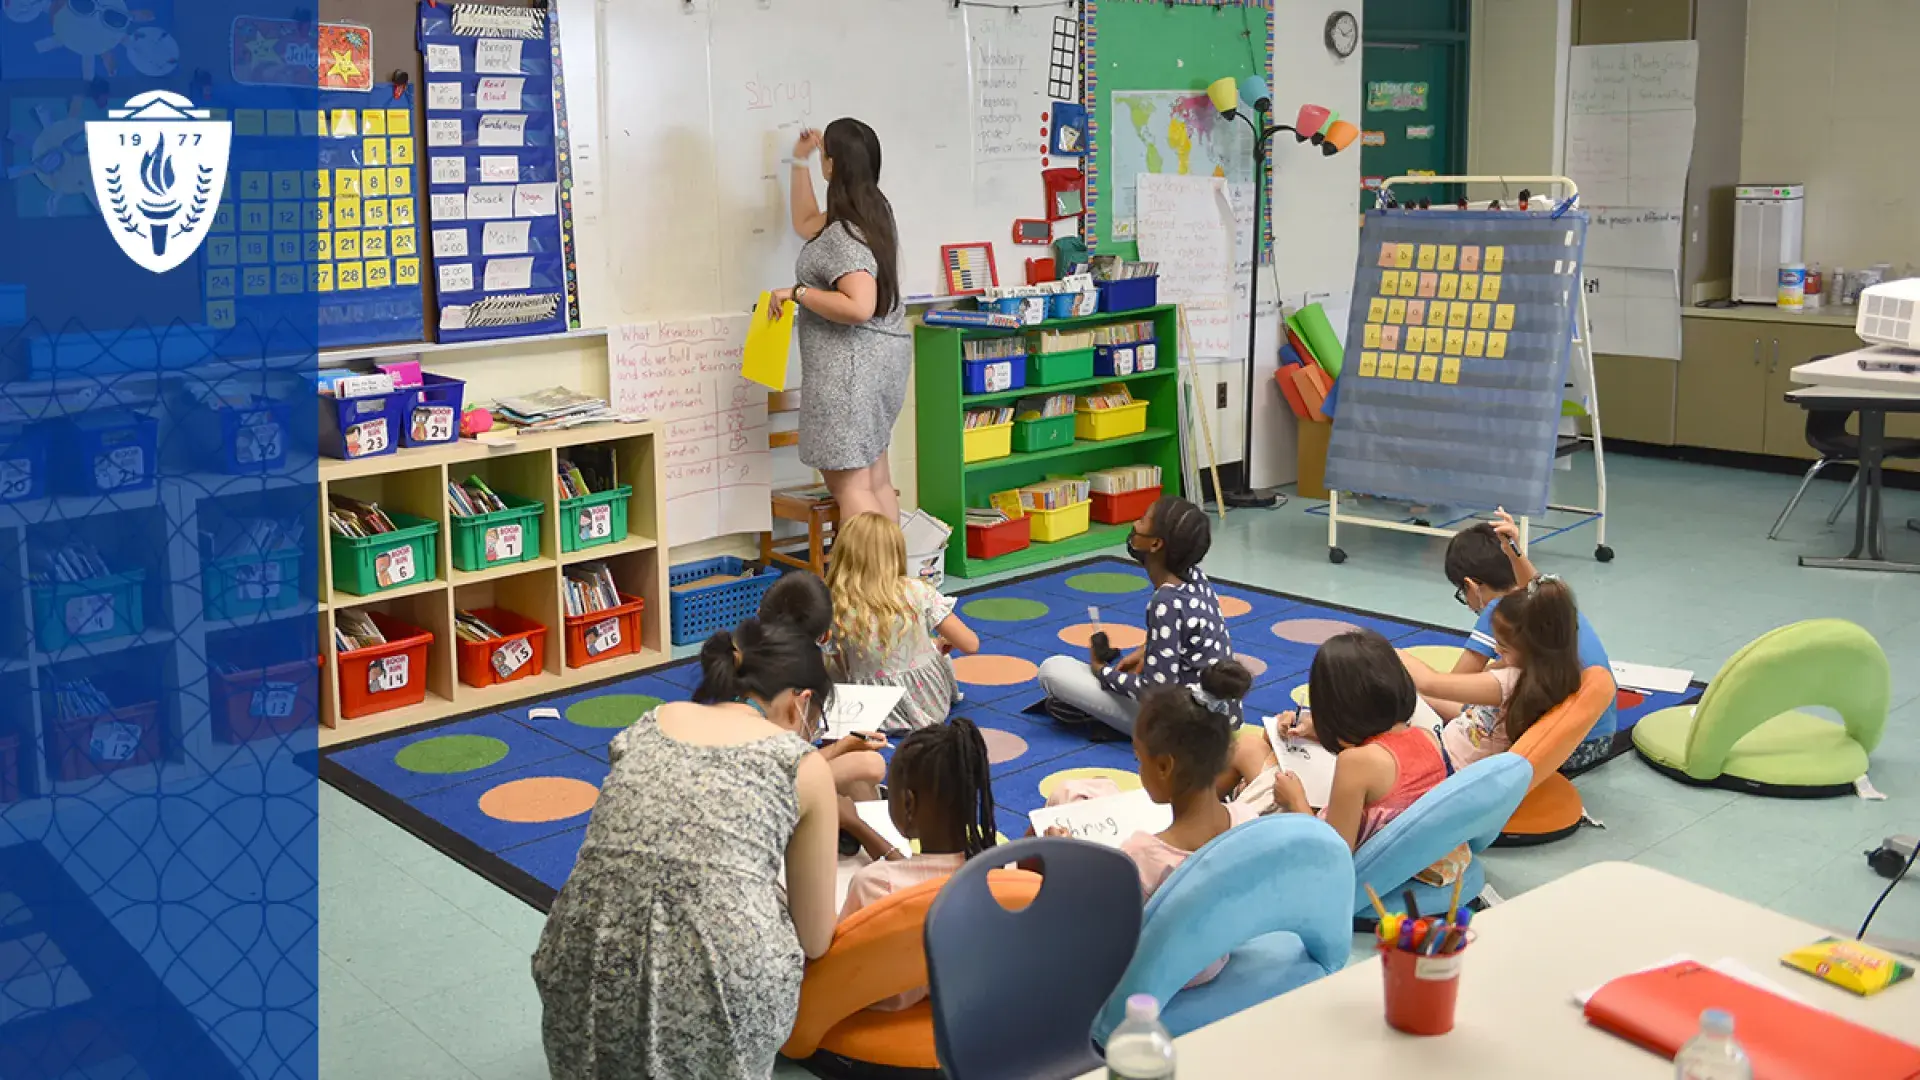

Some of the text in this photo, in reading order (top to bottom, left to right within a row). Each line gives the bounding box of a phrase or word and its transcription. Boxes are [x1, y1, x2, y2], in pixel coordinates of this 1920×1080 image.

[745, 72, 813, 115] shrug
[371, 145, 406, 158] 1 2
[312, 179, 321, 190] 6
[344, 178, 352, 189] 7
[370, 176, 378, 188] 8
[395, 176, 403, 187] 9
[472, 192, 543, 206] Snack Yoga
[280, 211, 294, 223] 12
[309, 209, 323, 222] 13
[340, 208, 354, 219] 14
[370, 206, 383, 218] 15
[396, 205, 409, 217] 16
[214, 244, 230, 256] 17
[309, 239, 326, 251] 20
[341, 238, 355, 250] 21
[366, 237, 382, 249] 22
[396, 235, 411, 247] 23
[212, 265, 415, 289] 24 25 26 27 28 29 30
[213, 308, 228, 320] 31
[620, 325, 649, 341] What
[711, 316, 730, 335] Do
[617, 367, 637, 380] and
[432, 425, 448, 438] 24
[367, 437, 383, 450] 23
[3, 481, 25, 492] 20
[597, 523, 604, 534] 8
[507, 544, 513, 555] 7
[399, 565, 407, 577] 6
[604, 633, 618, 646] 16
[515, 647, 528, 664] 15
[389, 674, 403, 686] 14
